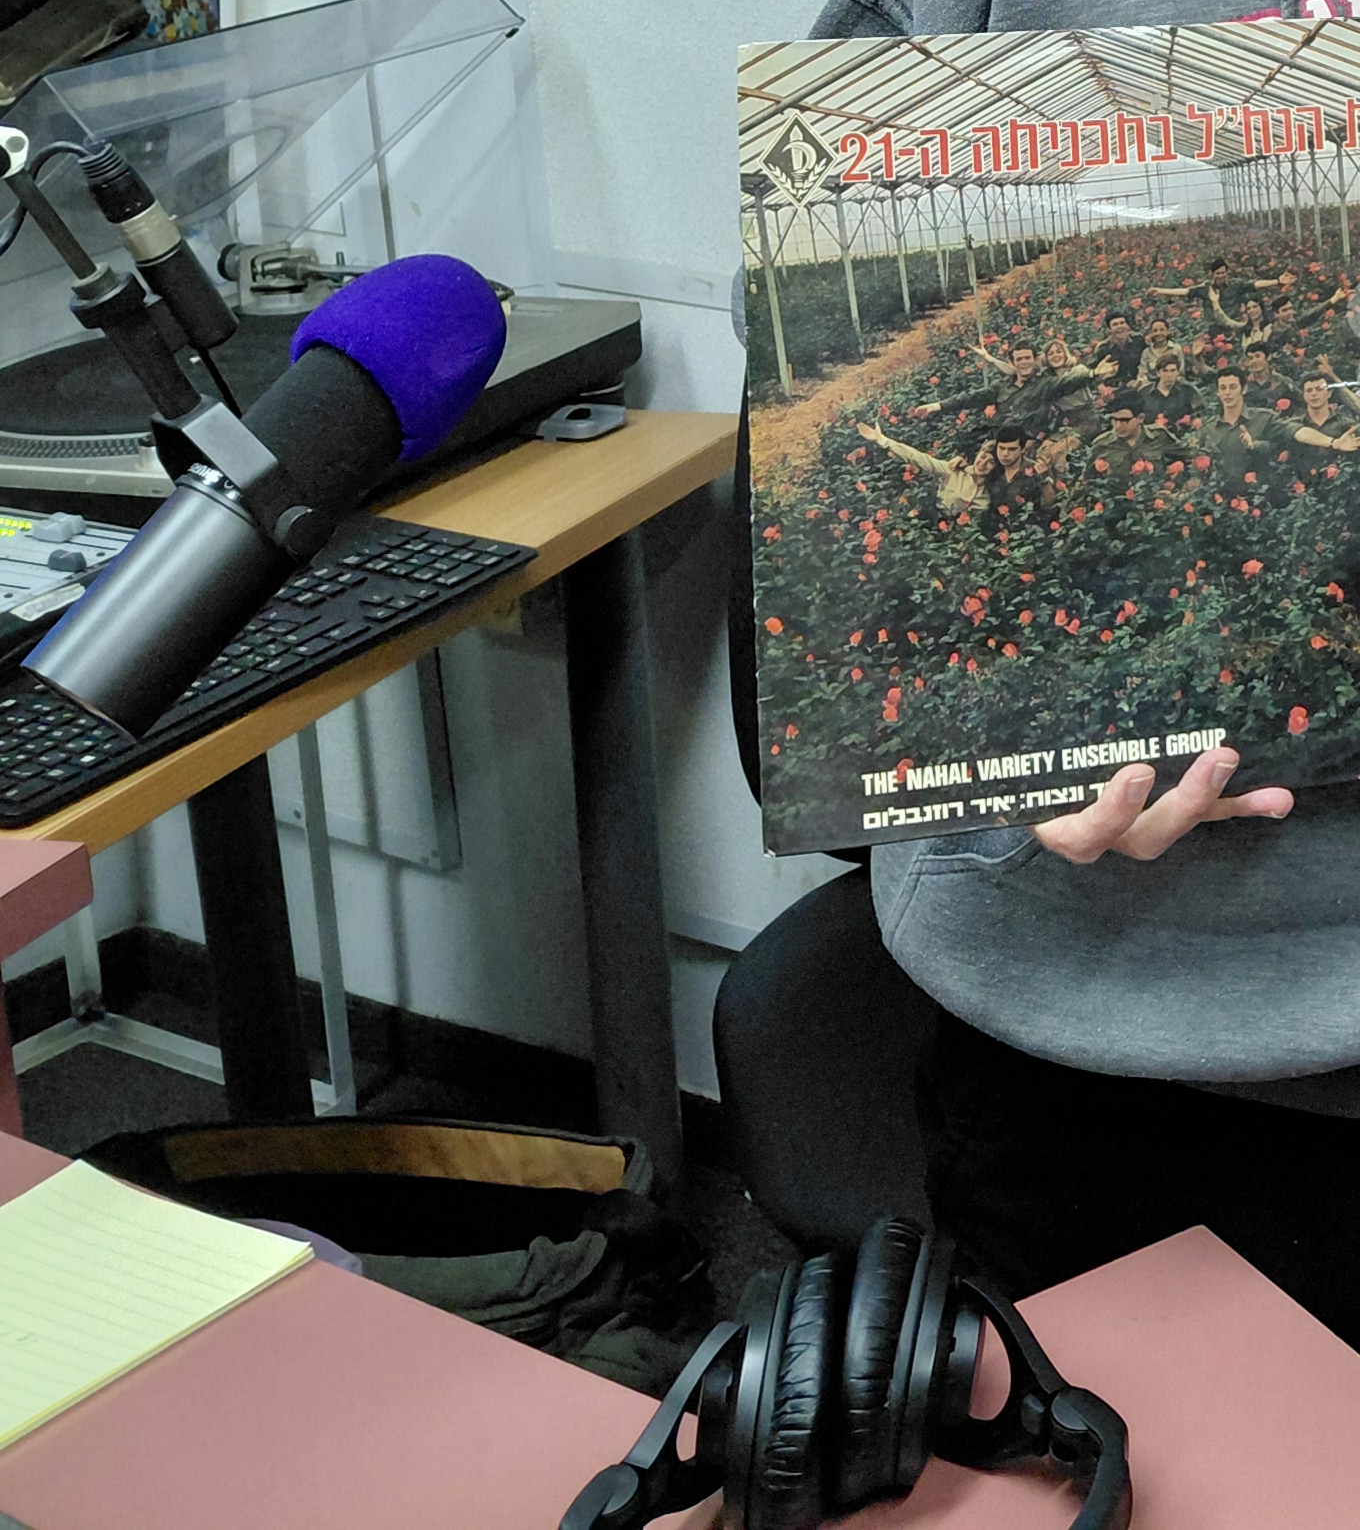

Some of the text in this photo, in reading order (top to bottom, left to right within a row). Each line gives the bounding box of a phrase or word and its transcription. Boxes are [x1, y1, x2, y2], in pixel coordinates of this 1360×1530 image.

[971, 112, 1178, 174] בתכניתה
[862, 728, 1227, 796] THE NAHAL VARIETY ENSEMBLE GROUP
[863, 801, 965, 830] רוזנבלום
[970, 796, 1016, 816] יאיר
